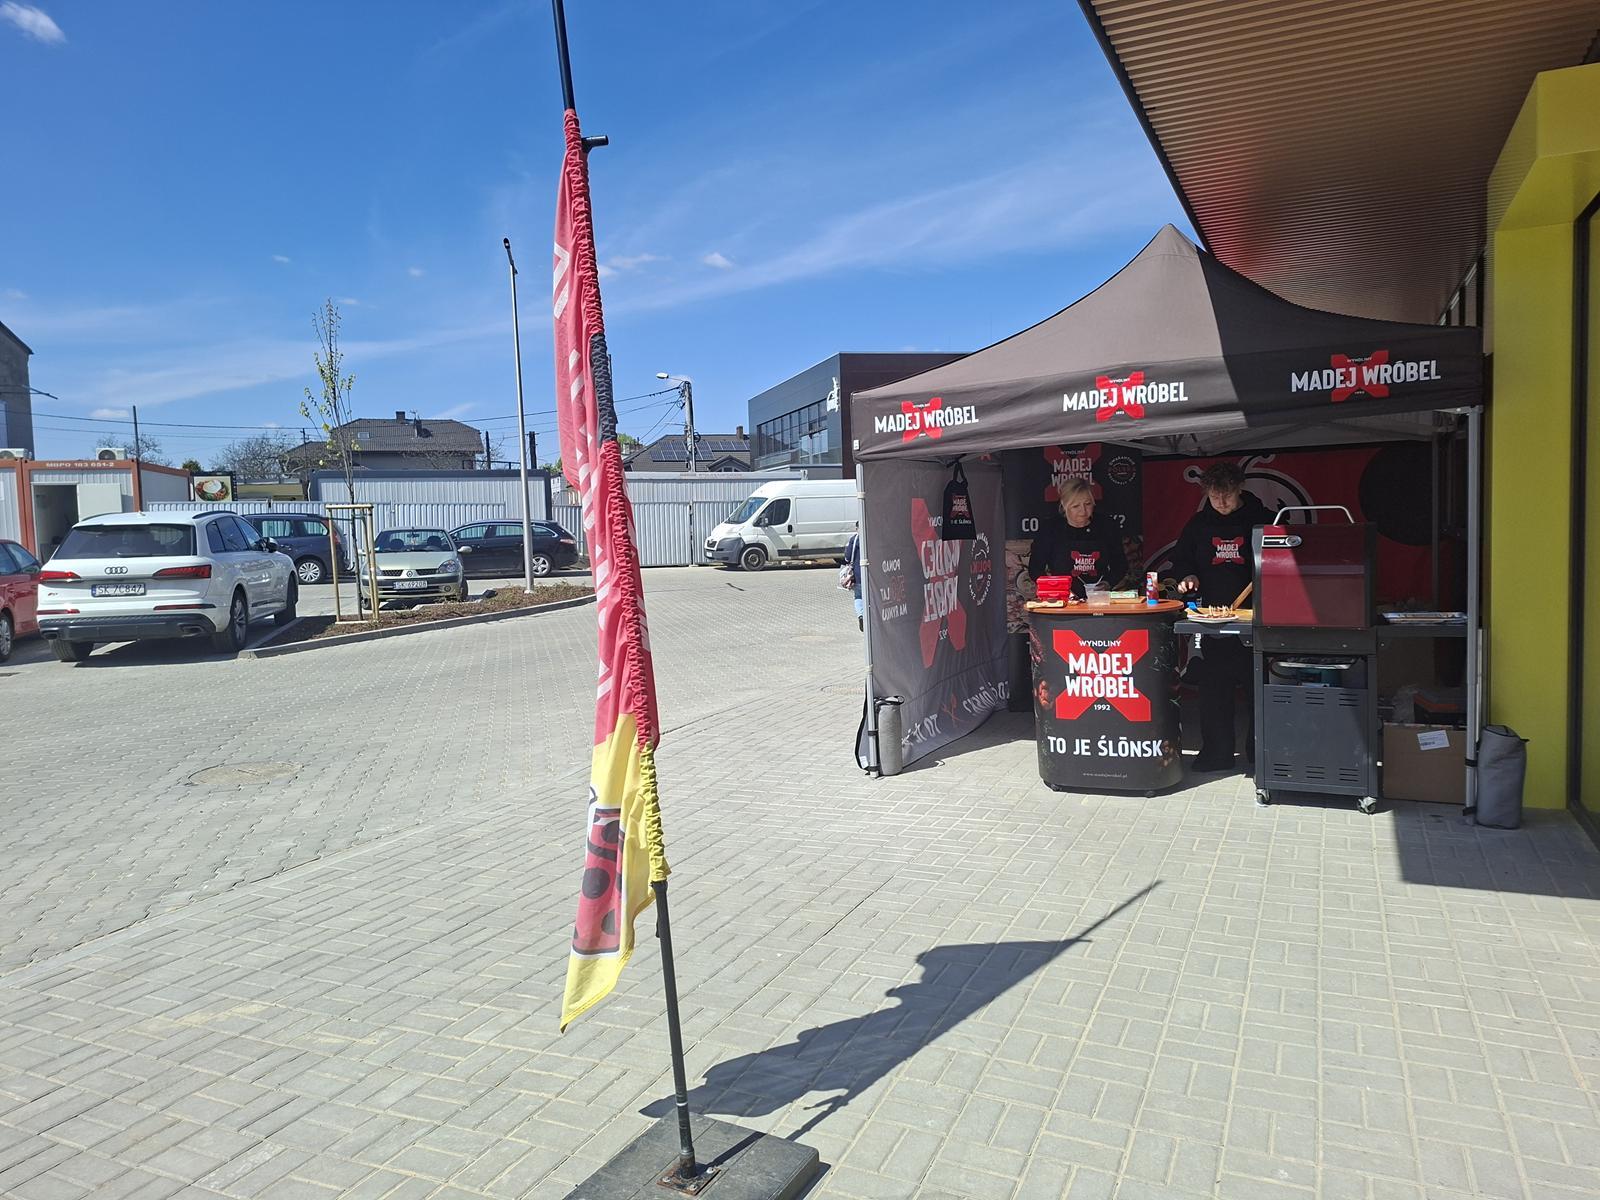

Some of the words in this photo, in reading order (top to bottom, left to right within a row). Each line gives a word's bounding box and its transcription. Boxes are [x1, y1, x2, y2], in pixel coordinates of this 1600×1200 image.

[1291, 367, 1357, 393] MADEJ
[1362, 360, 1441, 386] WRÓBEL
[1063, 387, 1118, 412] MADEJ
[1121, 381, 1189, 406] WRÓBEL
[875, 412, 920, 434] MADEJ
[923, 406, 979, 429] WRÓBEL
[1053, 458, 1092, 473] MADEJ
[1022, 518, 1039, 532] CO
[1078, 640, 1122, 648] WYNDLINY
[1068, 652, 1133, 675] MADEJ
[1064, 674, 1139, 698] WRÓBEL
[1047, 736, 1067, 754] TO
[1073, 739, 1091, 756] JE
[1097, 735, 1163, 758] ŚLŌNSK
